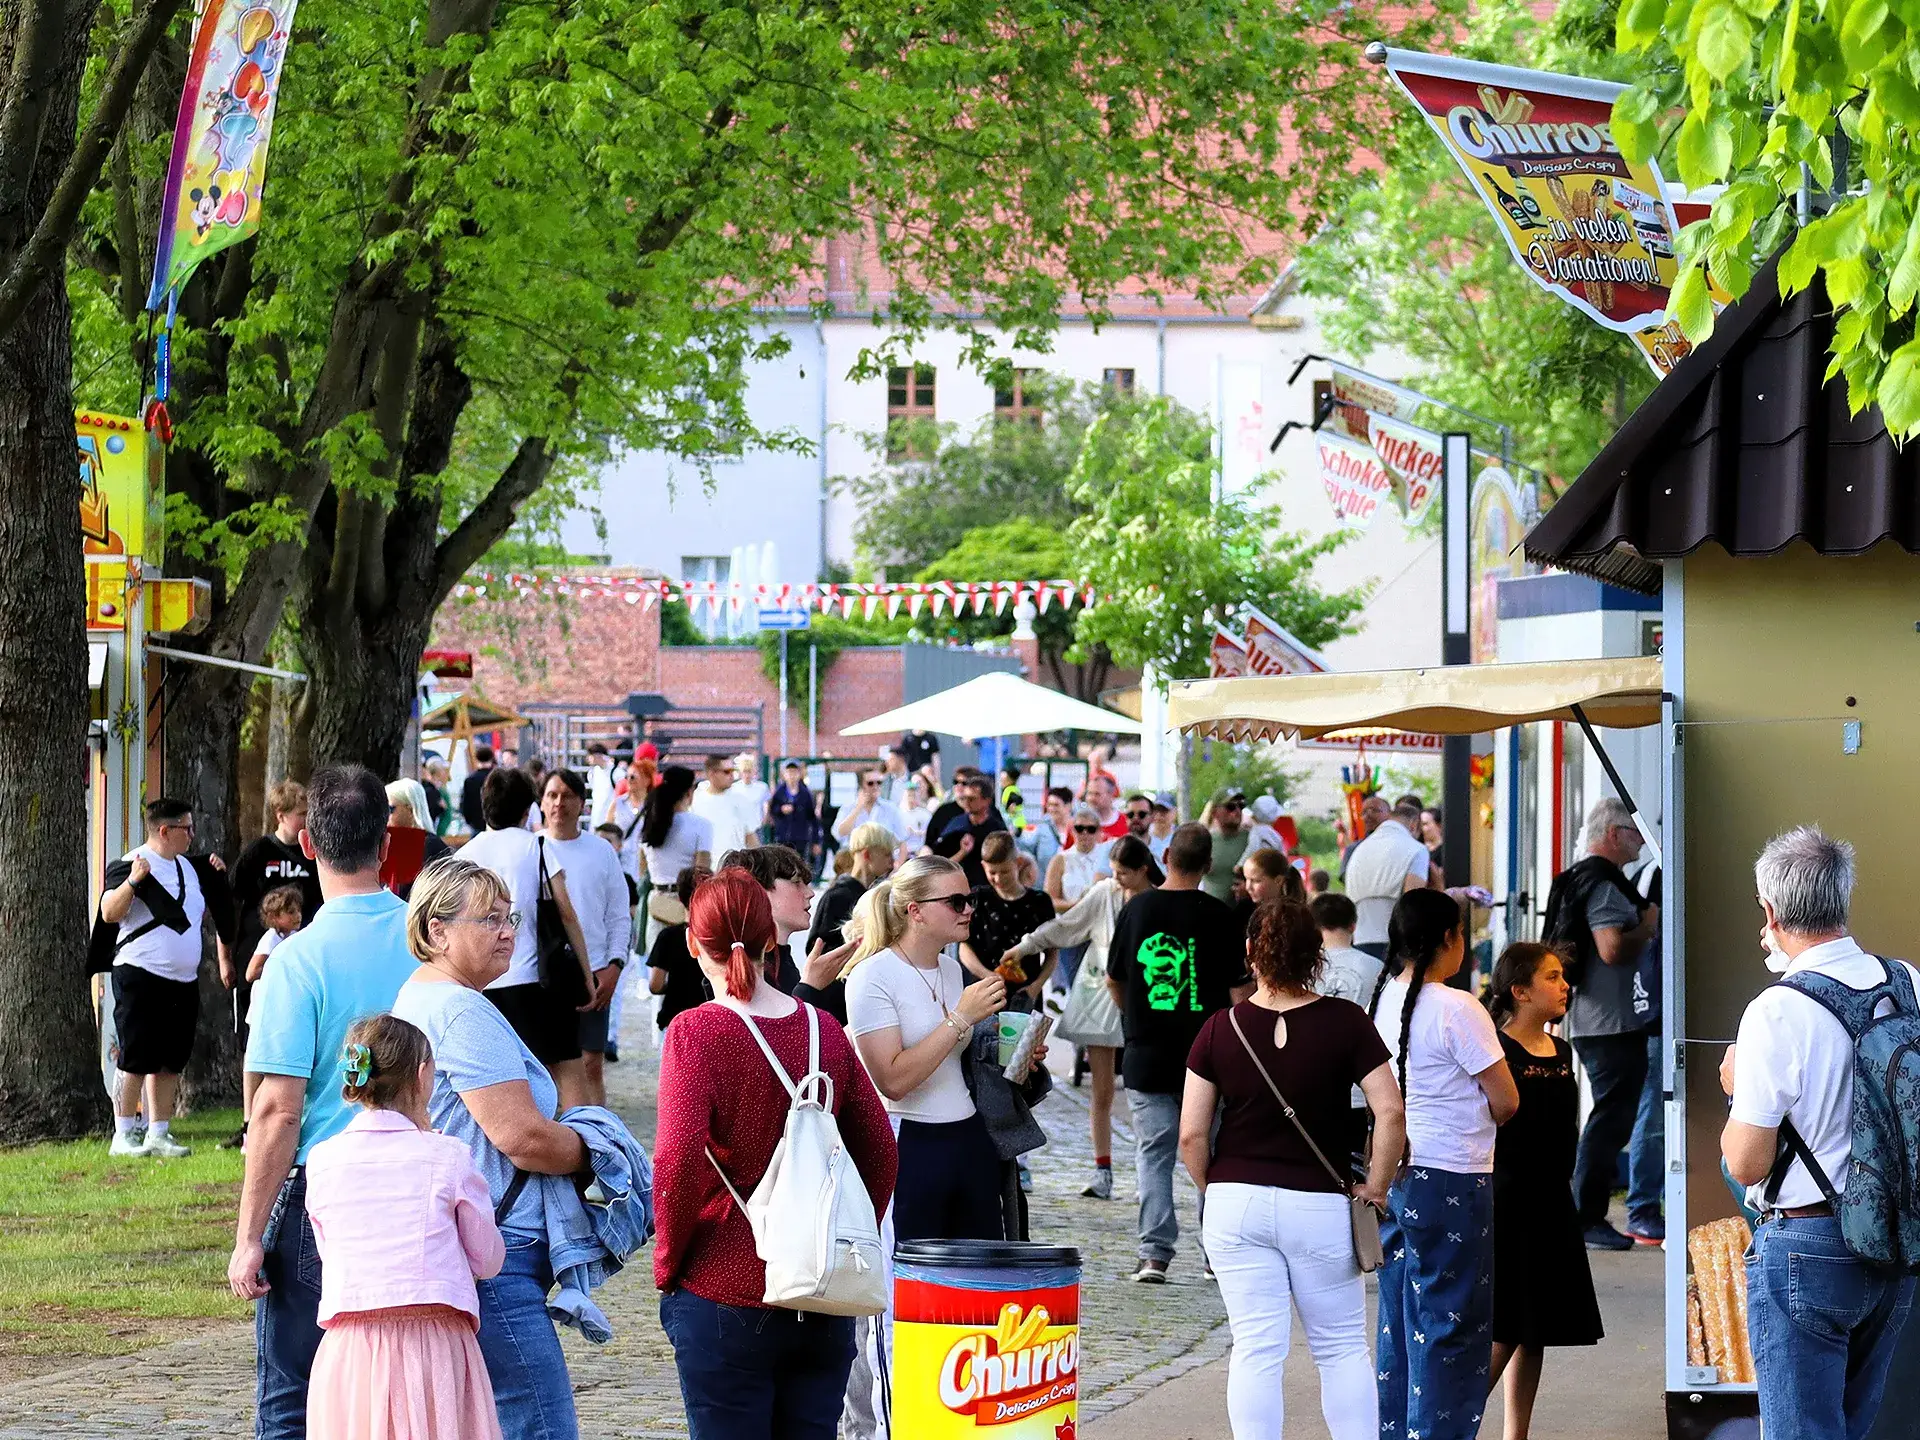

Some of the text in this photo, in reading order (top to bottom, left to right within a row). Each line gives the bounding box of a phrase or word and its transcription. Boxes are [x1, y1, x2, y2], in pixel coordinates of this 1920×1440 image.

[1448, 105, 1619, 158] Churros
[1521, 157, 1616, 175] Delicious Crispy
[1572, 207, 1632, 243] vielen
[1528, 241, 1661, 284] Variationen!
[265, 860, 310, 878] FILA
[995, 1395, 1049, 1420] Delicious
